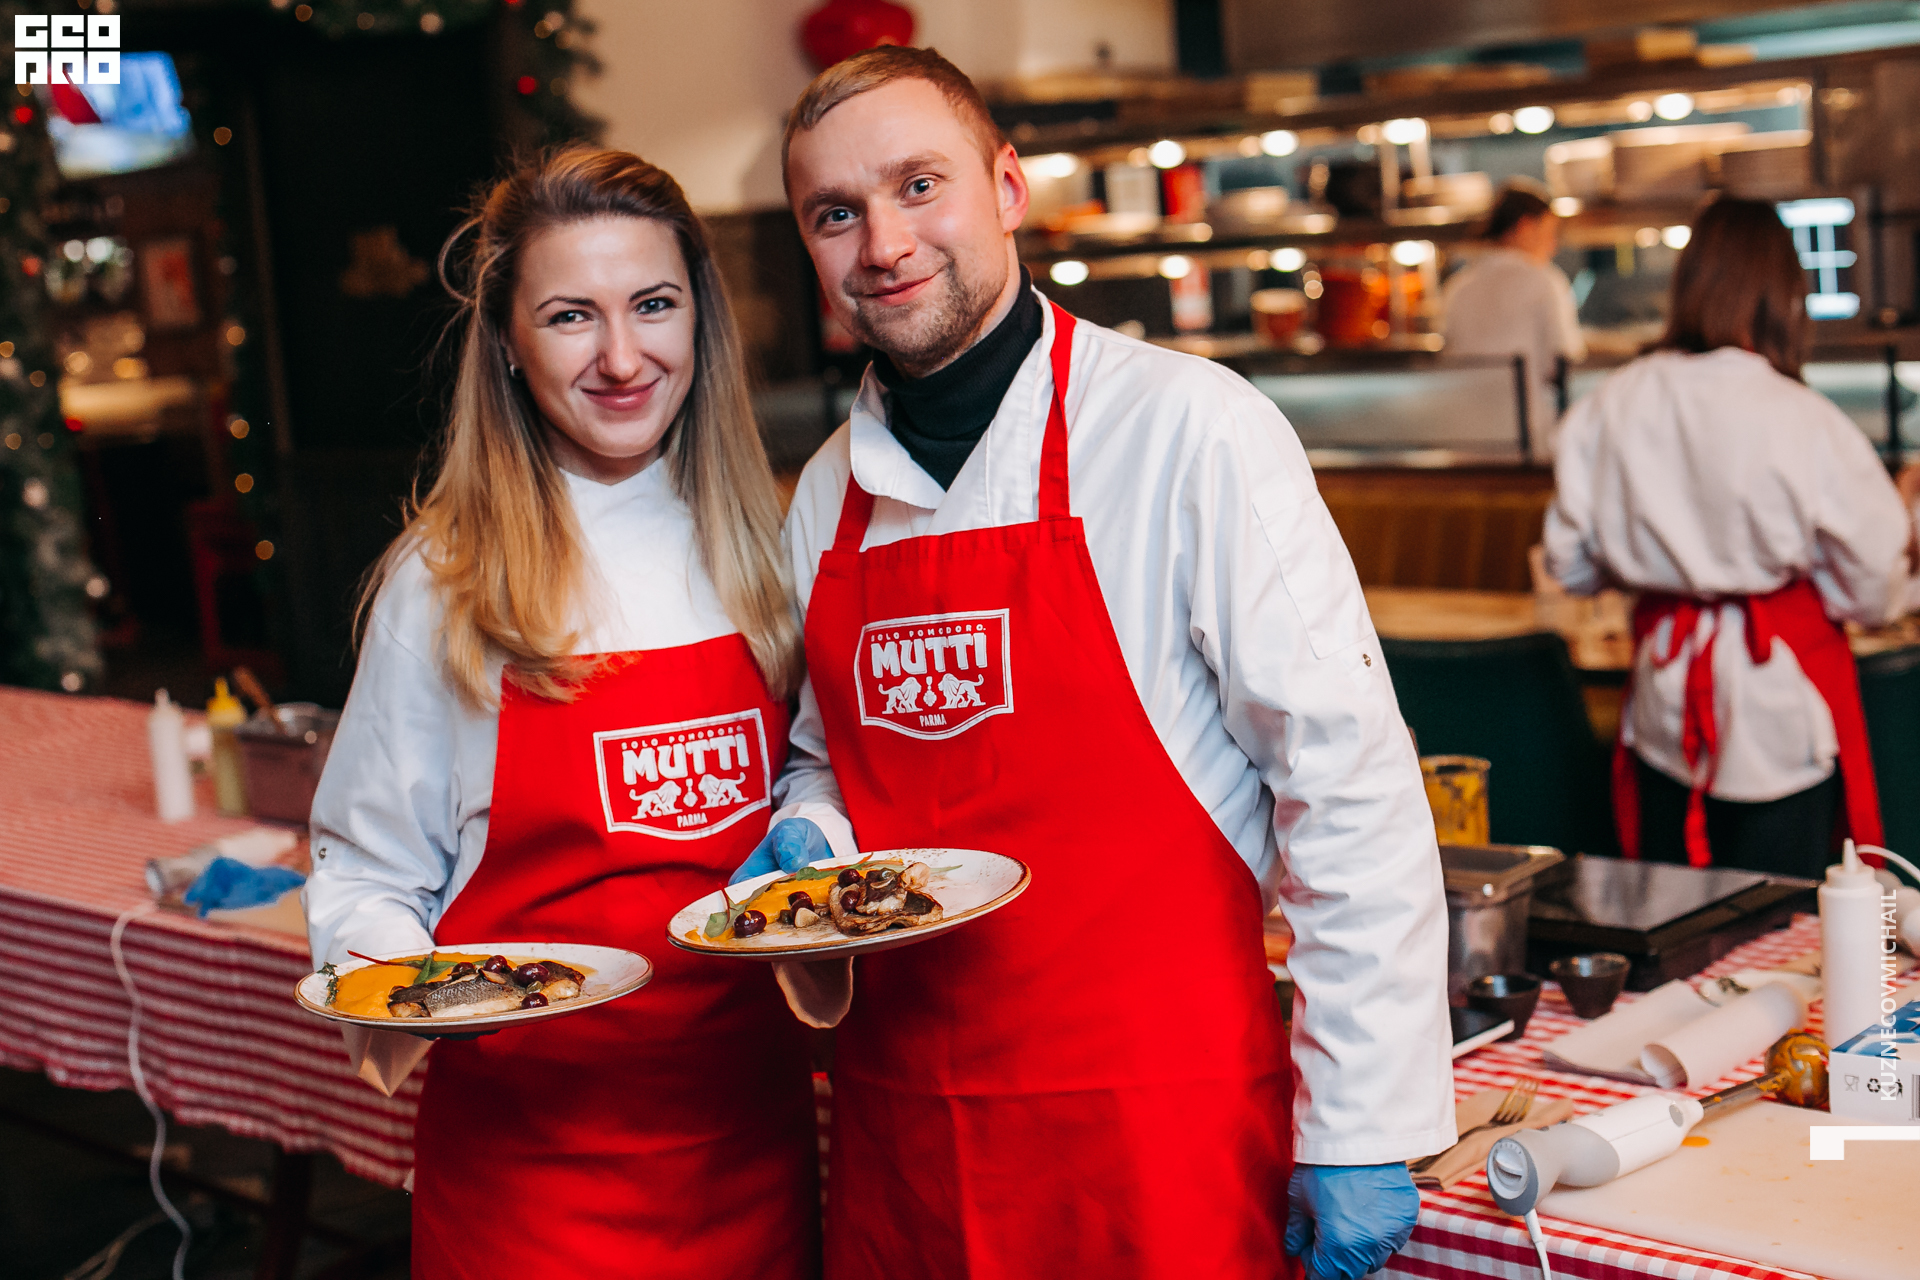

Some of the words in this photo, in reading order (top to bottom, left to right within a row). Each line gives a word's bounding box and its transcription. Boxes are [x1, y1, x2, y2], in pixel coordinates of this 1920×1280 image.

[870, 632, 900, 642] SOLO
[870, 632, 988, 678] MUTTI
[919, 714, 947, 727] PARMA
[621, 738, 659, 750] SOLO
[622, 733, 750, 786] MUTTI
[677, 812, 708, 828] PARMA
